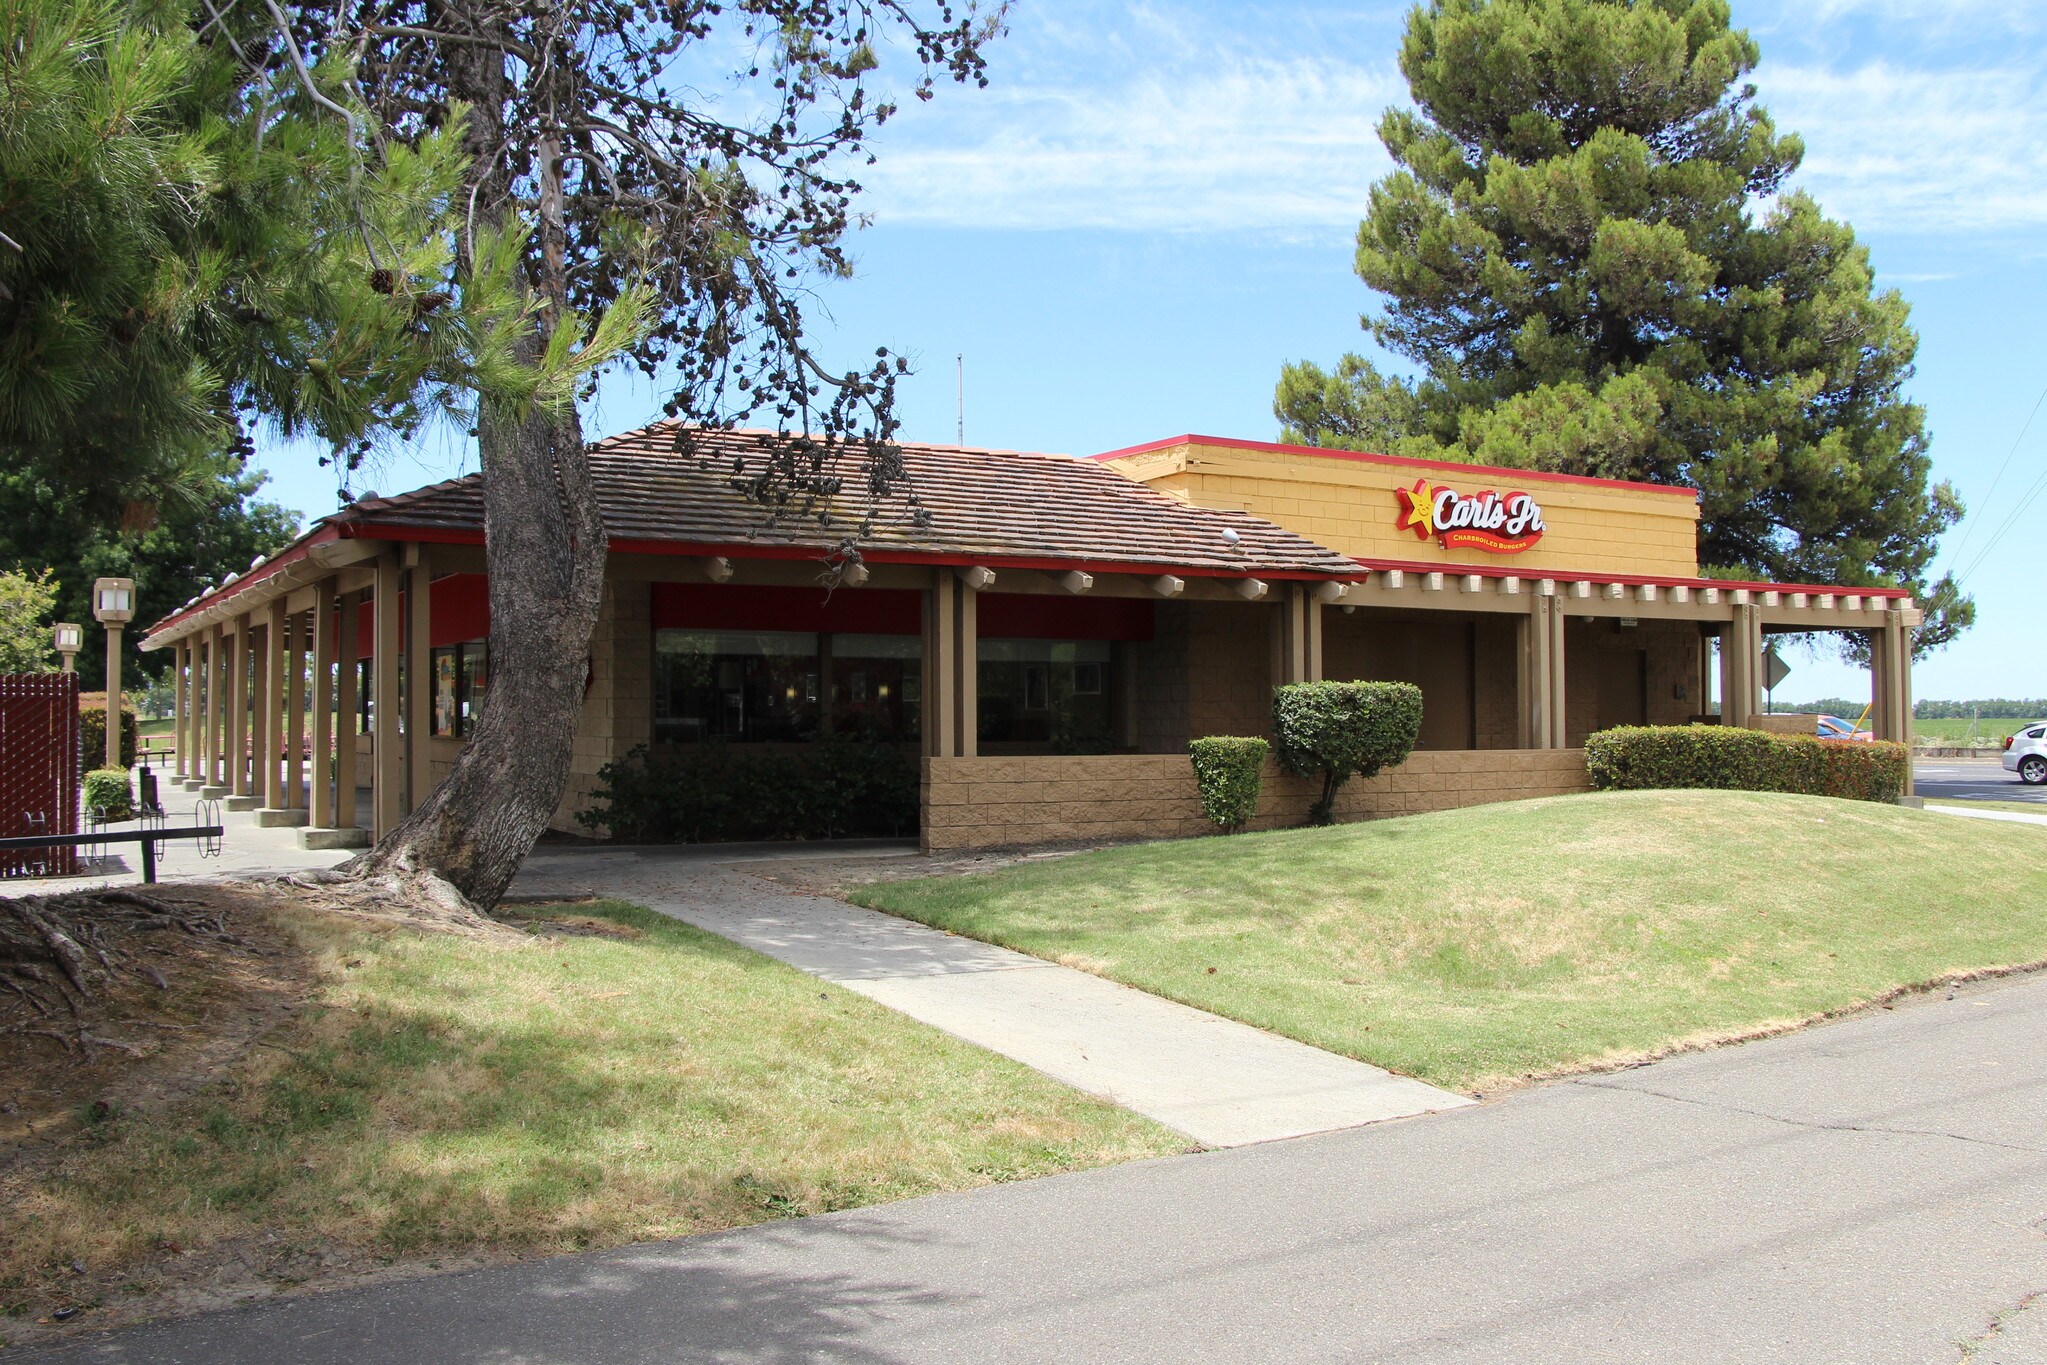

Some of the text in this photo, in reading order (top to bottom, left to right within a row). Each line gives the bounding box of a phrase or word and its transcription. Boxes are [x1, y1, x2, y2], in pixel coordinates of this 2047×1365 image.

[1433, 490, 1507, 530] Carl's
[1453, 534, 1527, 550] CHARBROILED BURGERS
